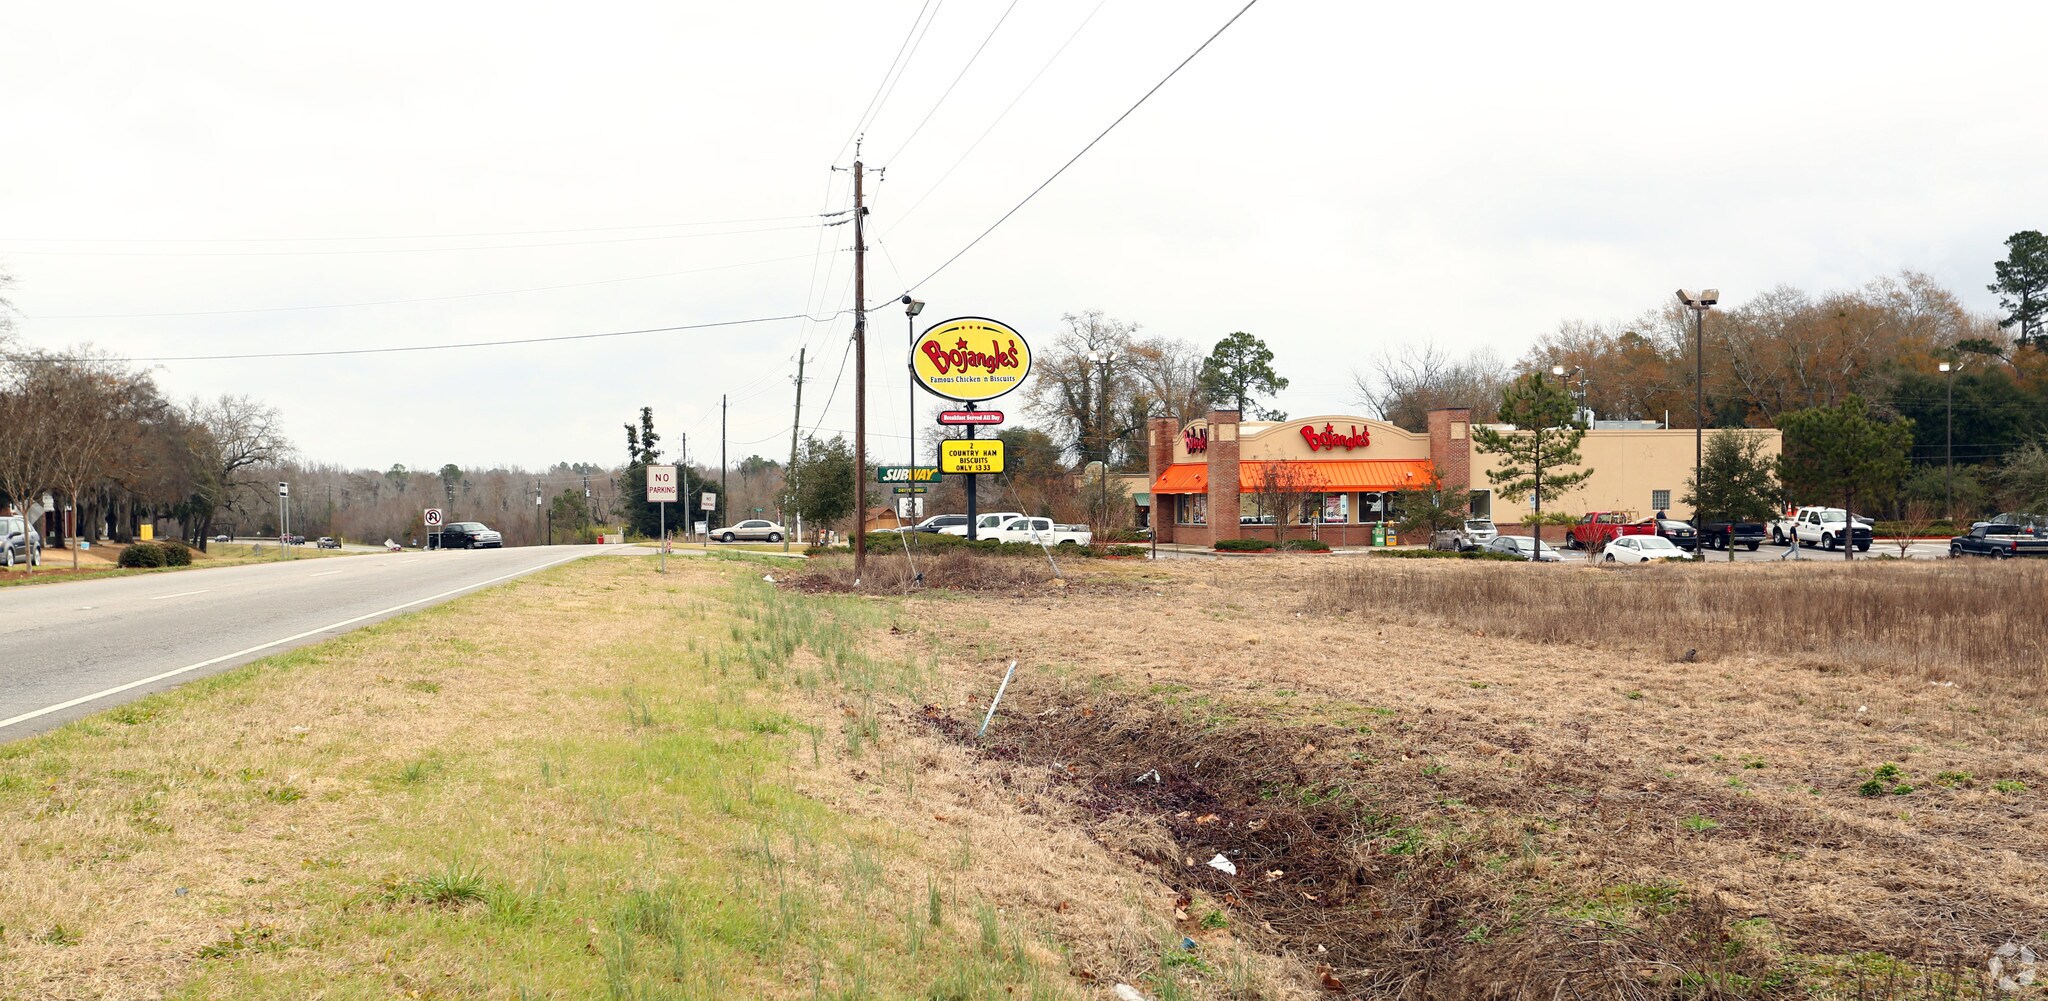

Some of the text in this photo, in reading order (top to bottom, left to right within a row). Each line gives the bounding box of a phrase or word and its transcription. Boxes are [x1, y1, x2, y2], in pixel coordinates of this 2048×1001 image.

[991, 414, 1000, 422] Day
[655, 473, 669, 482] NO
[882, 468, 938, 481] SUBWAY
[650, 486, 676, 494] PARKING
